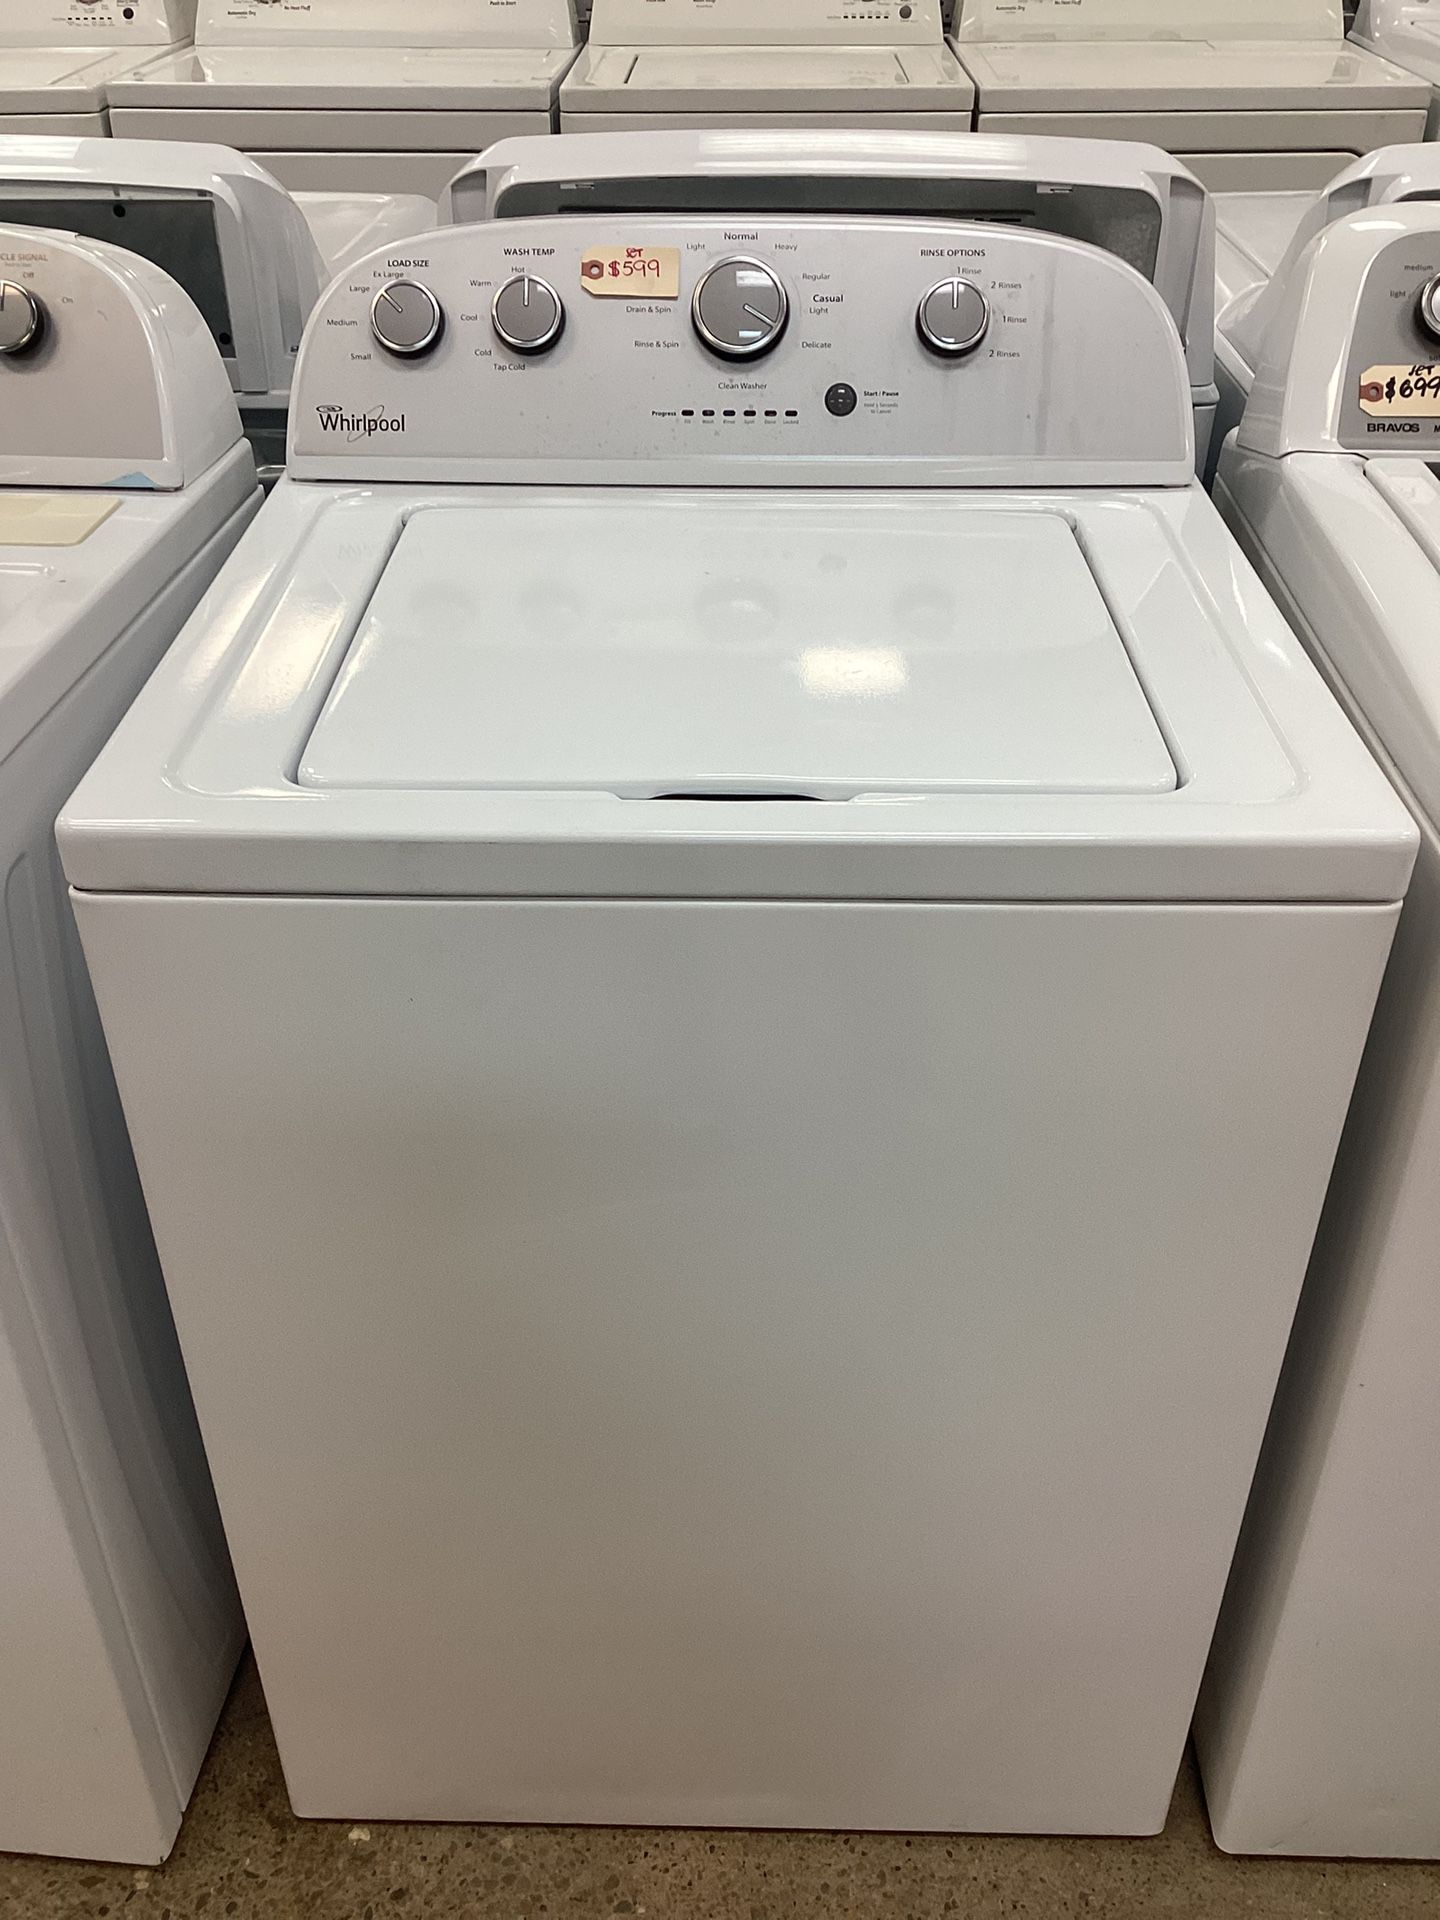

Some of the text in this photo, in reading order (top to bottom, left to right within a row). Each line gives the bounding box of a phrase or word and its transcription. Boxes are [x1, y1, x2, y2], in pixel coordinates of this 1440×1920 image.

[724, 232, 759, 241] Normal
[503, 247, 556, 256] WASH TEMP
[686, 243, 706, 251] Light
[774, 243, 798, 252] Heavy
[920, 248, 986, 257] RINSE OPTIONS
[387, 259, 430, 268] LOAD SIZE
[511, 266, 526, 274] Hot
[608, 259, 661, 279] $599
[962, 266, 982, 275] Rinse
[373, 271, 404, 280] Ex Large
[802, 272, 831, 281] Regular
[470, 279, 492, 287] Warm
[991, 280, 1022, 290] 2 Rinses
[349, 284, 371, 293] Large
[813, 294, 844, 303] Casual
[626, 305, 647, 313] Drain
[655, 305, 672, 314] Spin
[809, 306, 829, 315] Light
[460, 313, 478, 321] Cool
[1007, 316, 1028, 324] Rinse
[326, 318, 358, 327] Medium
[634, 340, 655, 348] Rinse
[662, 340, 680, 350] Spin
[801, 340, 832, 350] Delicate
[350, 353, 372, 361] Small
[474, 348, 493, 357] Cold
[989, 349, 1021, 359] 2 Rinses
[493, 362, 526, 372] Tap Cold
[718, 382, 768, 391] Clean Washer
[1385, 376, 1440, 403] $699
[651, 410, 677, 418] Progress
[319, 413, 405, 437] Whirlpool
[1366, 422, 1421, 433] BRAVOS
